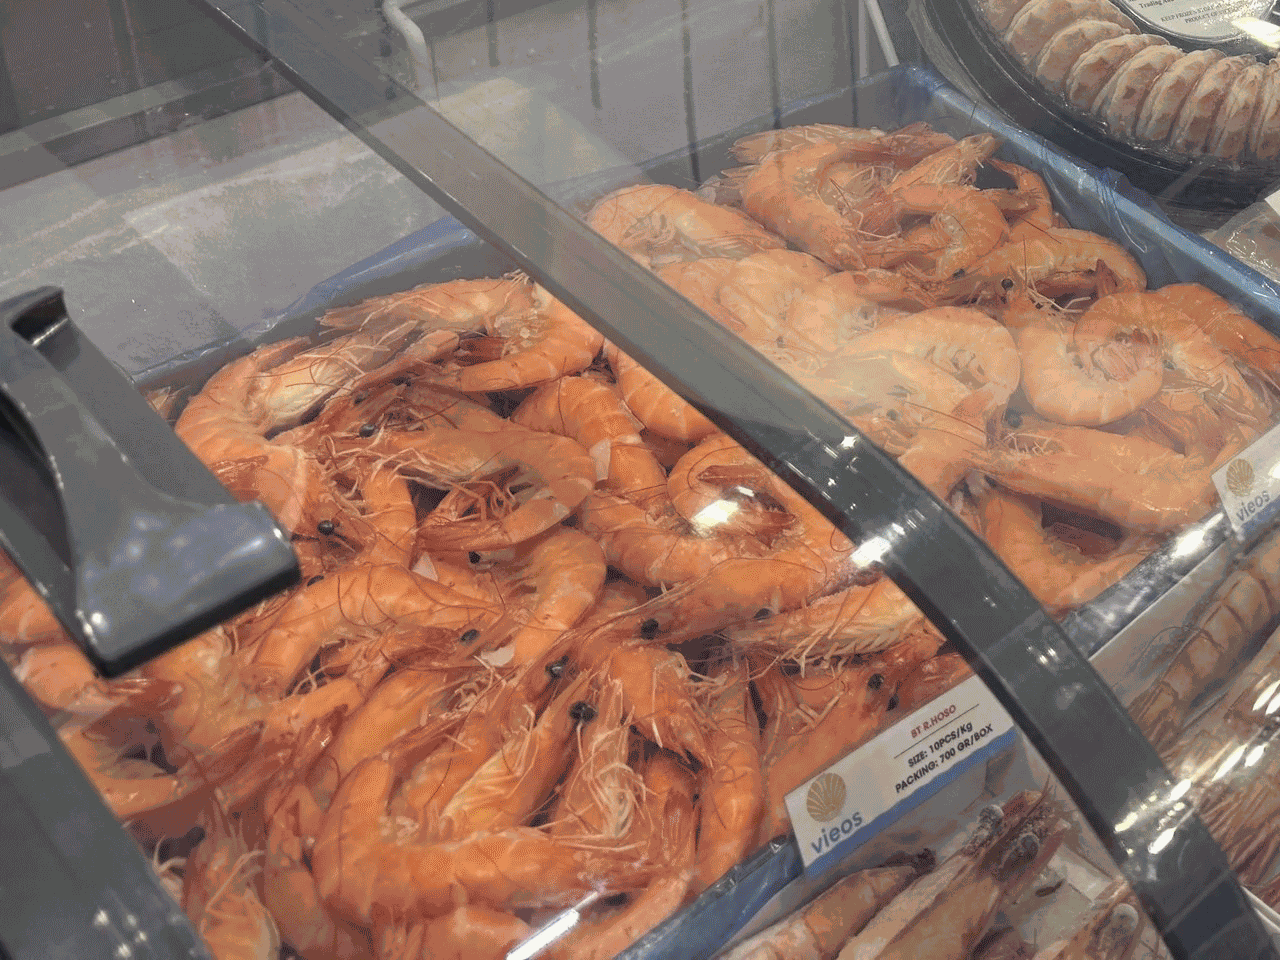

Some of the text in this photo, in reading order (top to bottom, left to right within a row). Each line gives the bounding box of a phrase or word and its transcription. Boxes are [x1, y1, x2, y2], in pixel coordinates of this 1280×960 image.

[1236, 491, 1271, 523] vieos
[910, 705, 957, 737] BT R.HOSO
[894, 725, 993, 792] PACKING: 700 GR/BOX
[907, 722, 973, 766] SIZE: 10PCS/Kg
[810, 812, 864, 855] vieos
